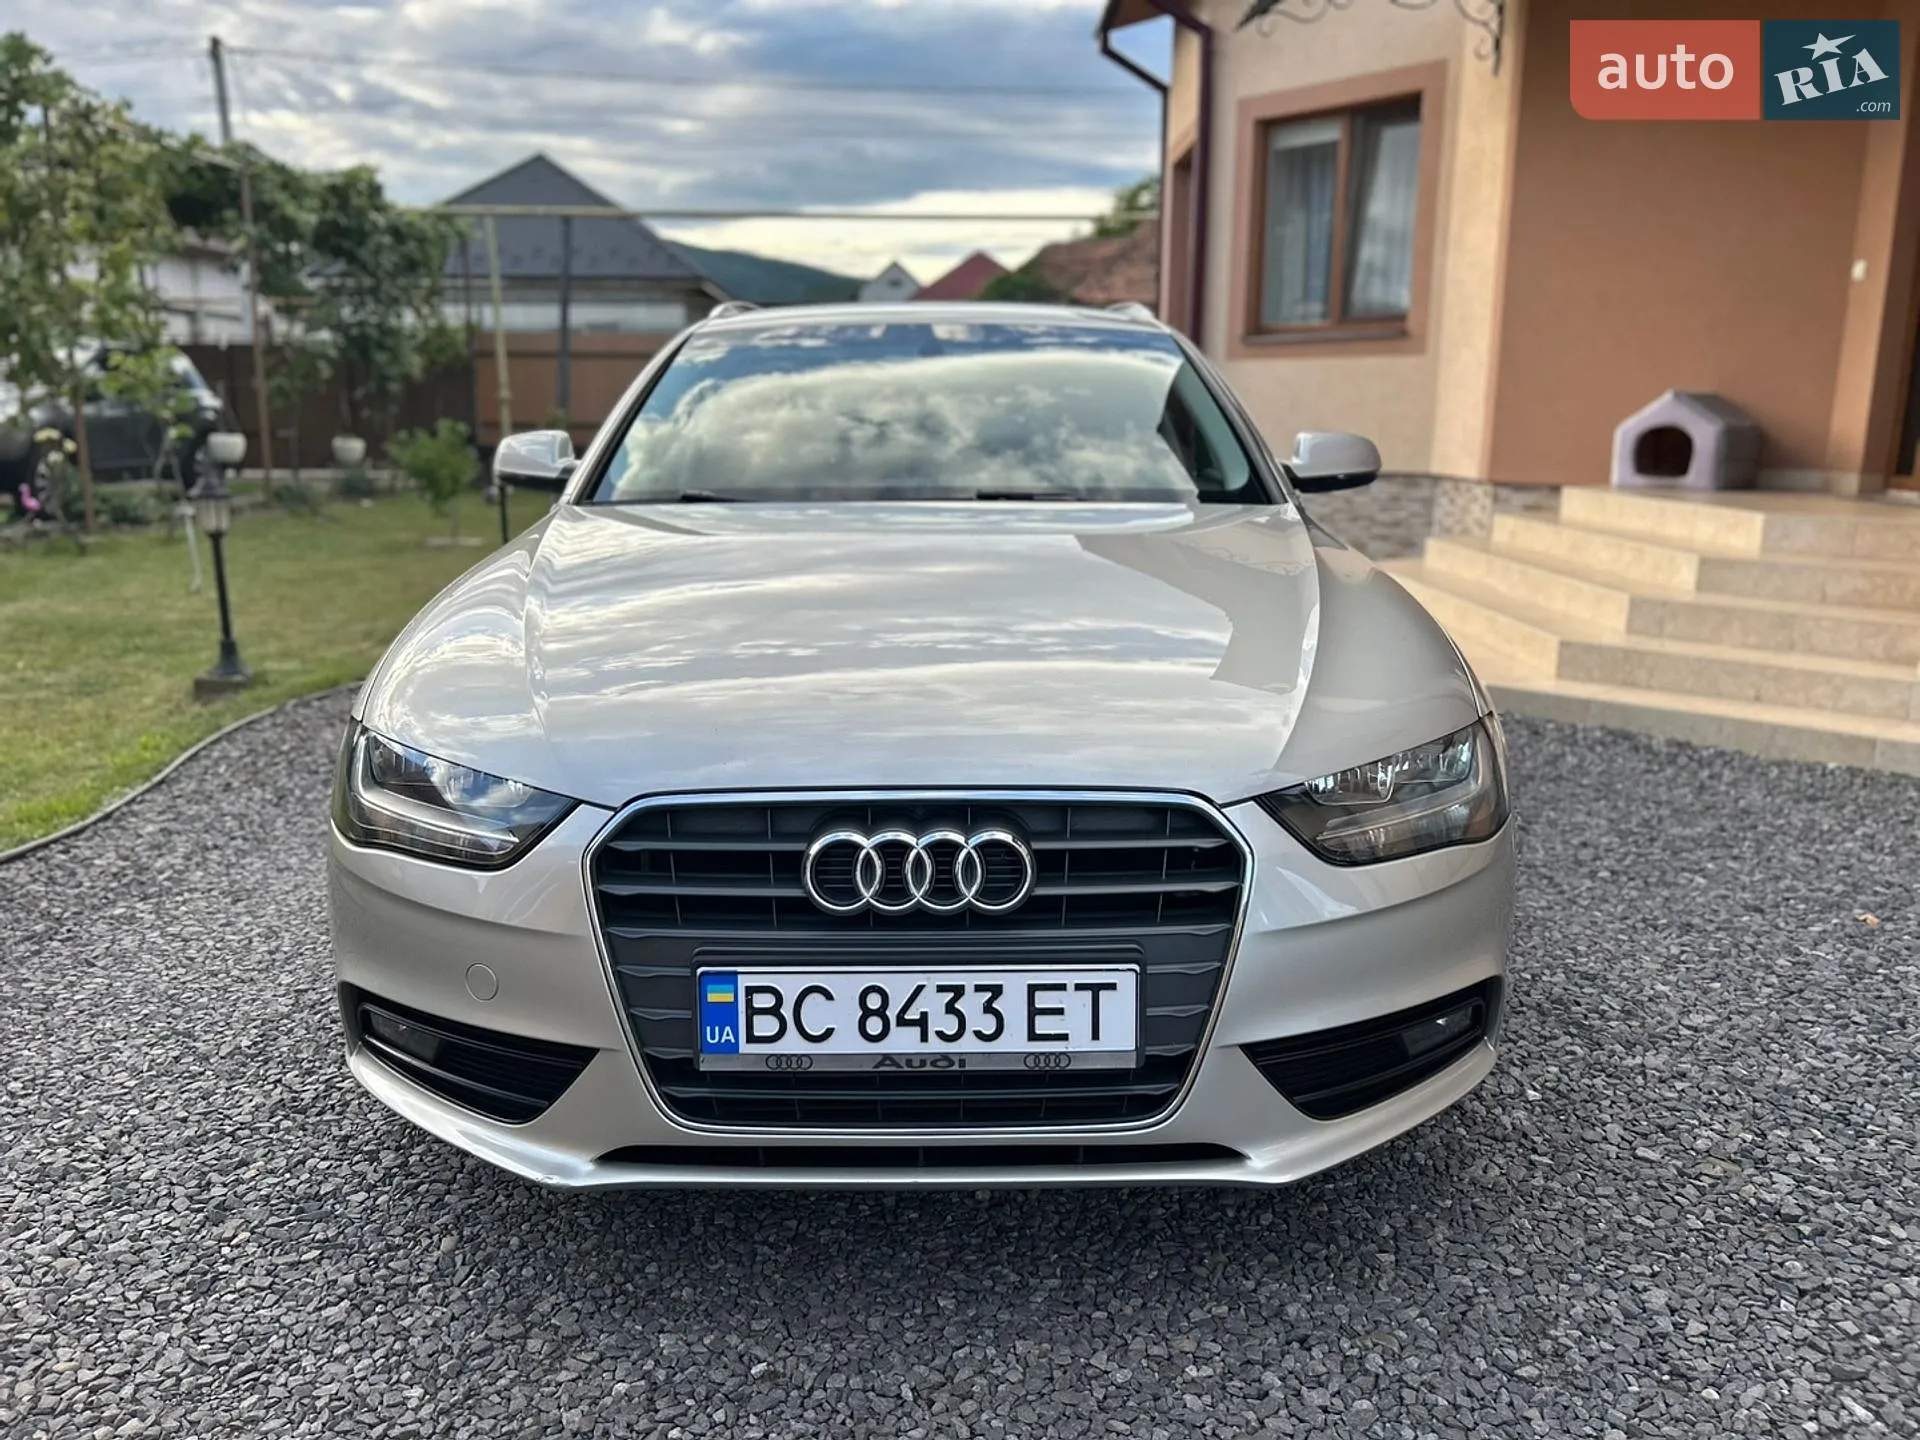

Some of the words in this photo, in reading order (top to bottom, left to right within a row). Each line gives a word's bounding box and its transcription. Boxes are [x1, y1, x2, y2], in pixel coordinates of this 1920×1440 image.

[744, 984, 835, 1044] BC
[857, 984, 1005, 1043] 8433
[1026, 982, 1117, 1042] ET
[706, 1026, 735, 1043] UA
[872, 1054, 966, 1069] Audi
